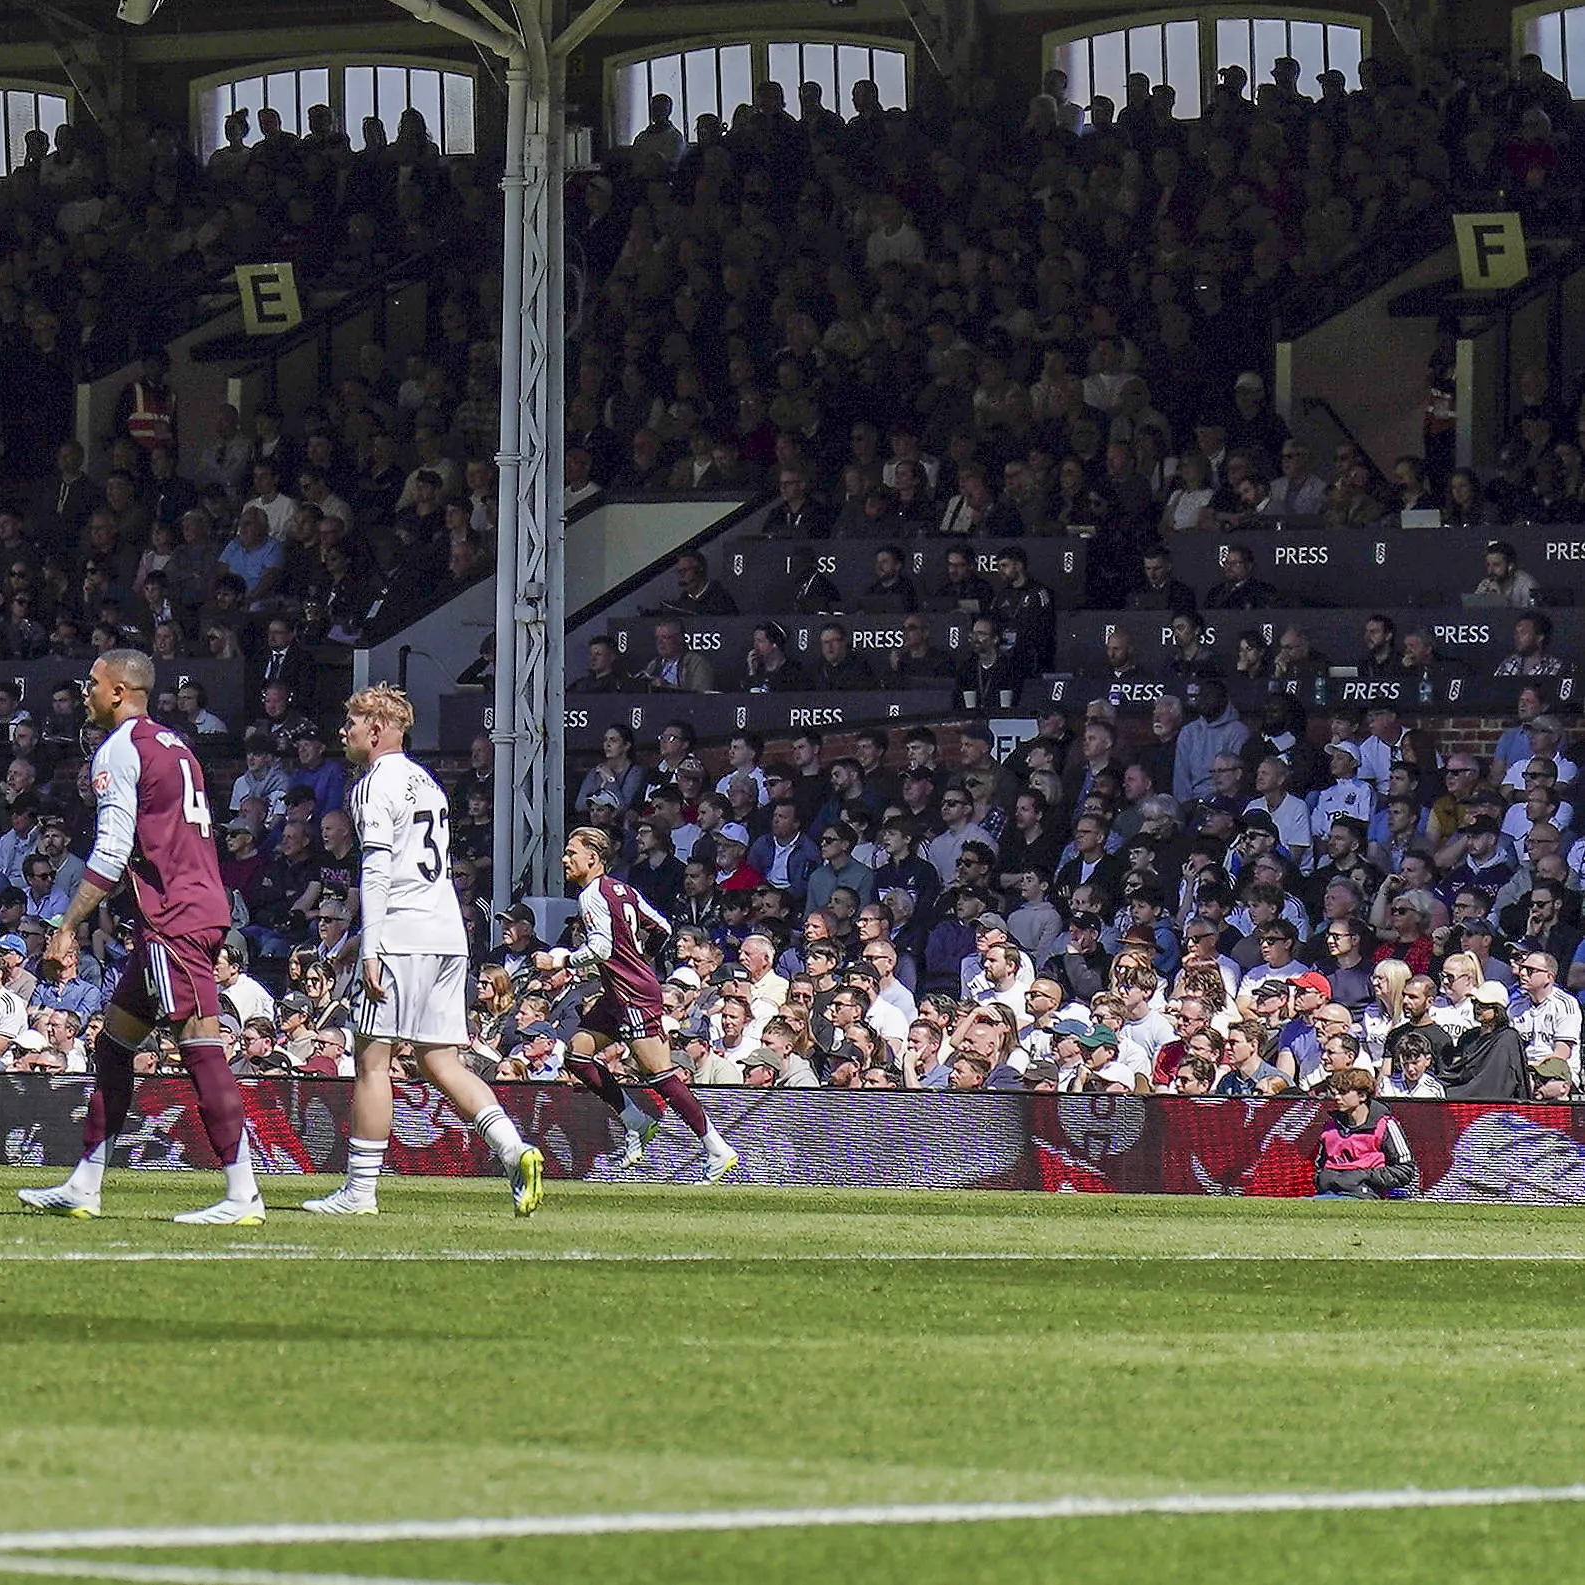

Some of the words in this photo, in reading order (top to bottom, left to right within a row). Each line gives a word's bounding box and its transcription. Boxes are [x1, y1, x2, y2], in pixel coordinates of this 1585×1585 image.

[1472, 224, 1506, 277] F
[250, 274, 288, 323] E
[1274, 546, 1329, 565] PRESS
[851, 629, 905, 649] PRESS
[1433, 624, 1490, 644] PRESS
[1109, 682, 1166, 702] PRESS
[1342, 681, 1401, 701] PRESS
[789, 707, 844, 727] PRESS
[178, 757, 213, 841] 4
